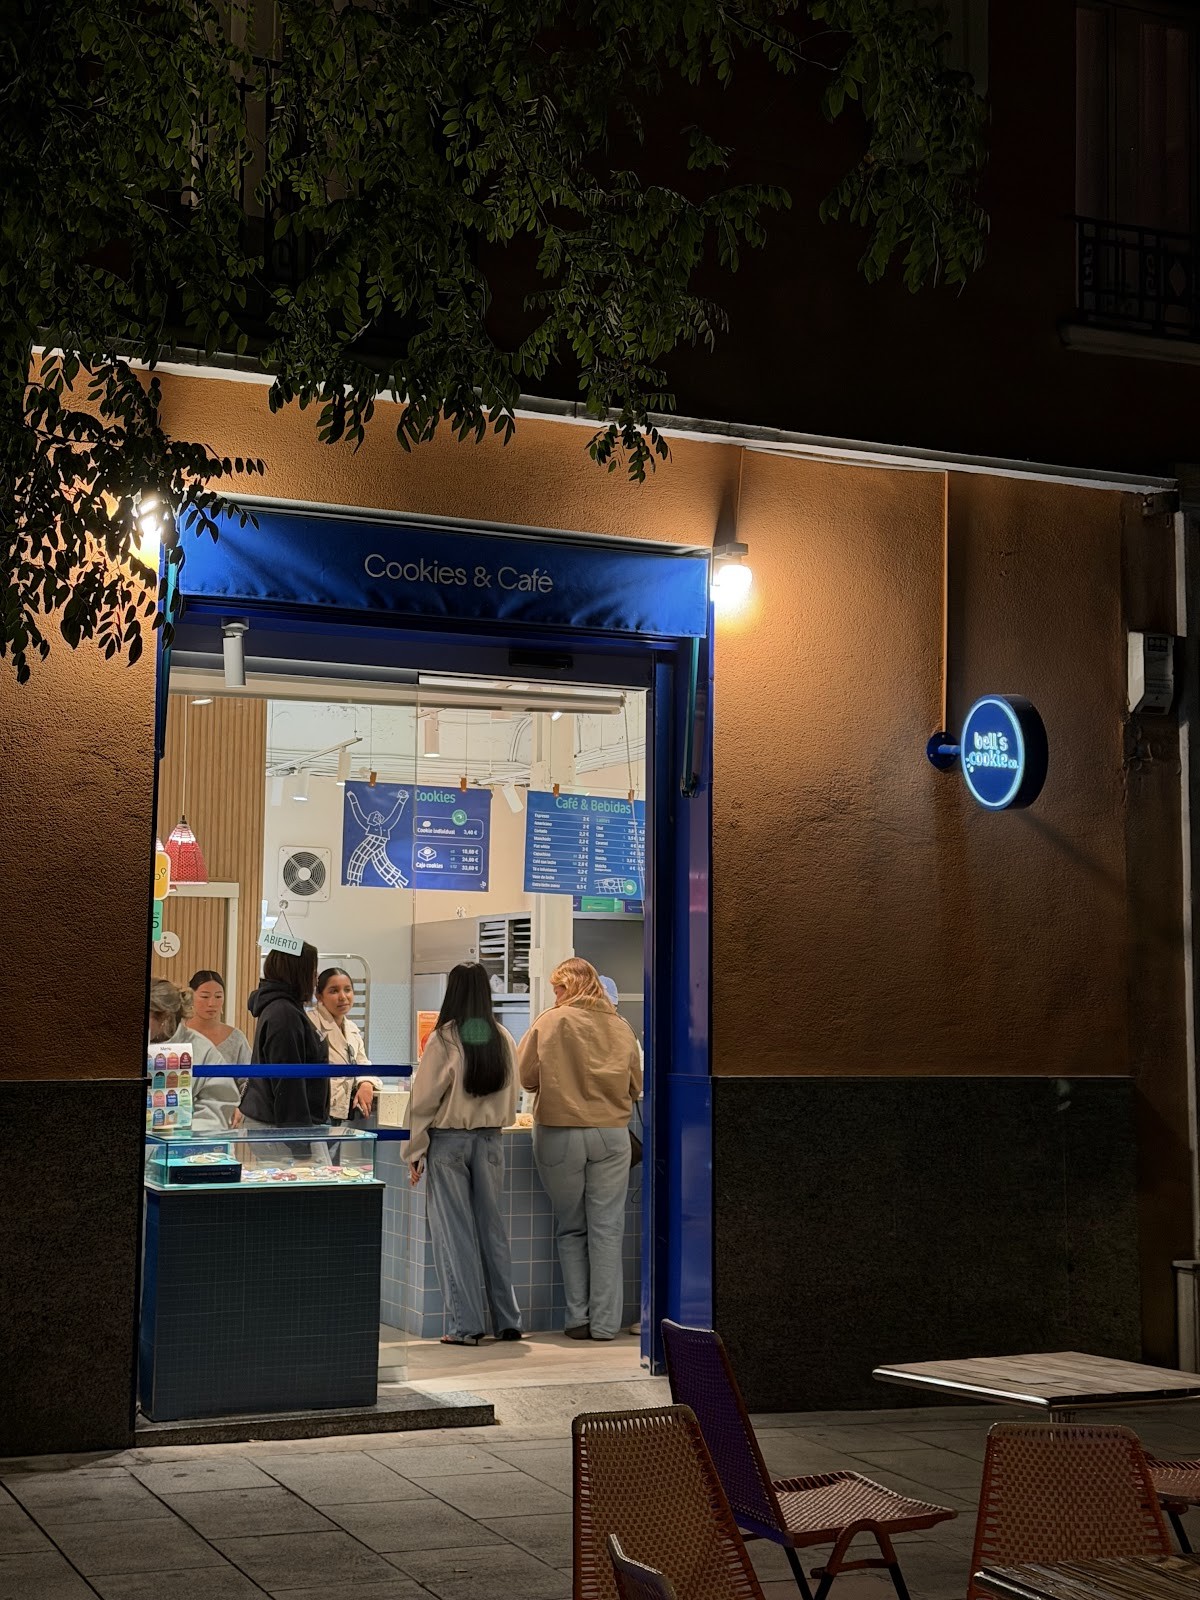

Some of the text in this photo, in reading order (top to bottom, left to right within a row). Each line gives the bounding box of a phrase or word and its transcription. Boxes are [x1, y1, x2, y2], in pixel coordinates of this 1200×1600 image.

[364, 553, 554, 593] Cookies & Café
[974, 731, 1009, 751] bell's
[969, 750, 1008, 768] cookie
[415, 789, 456, 803] Cookies
[556, 797, 631, 814] Café & Bebidas
[264, 934, 298, 951] ABIERTO
